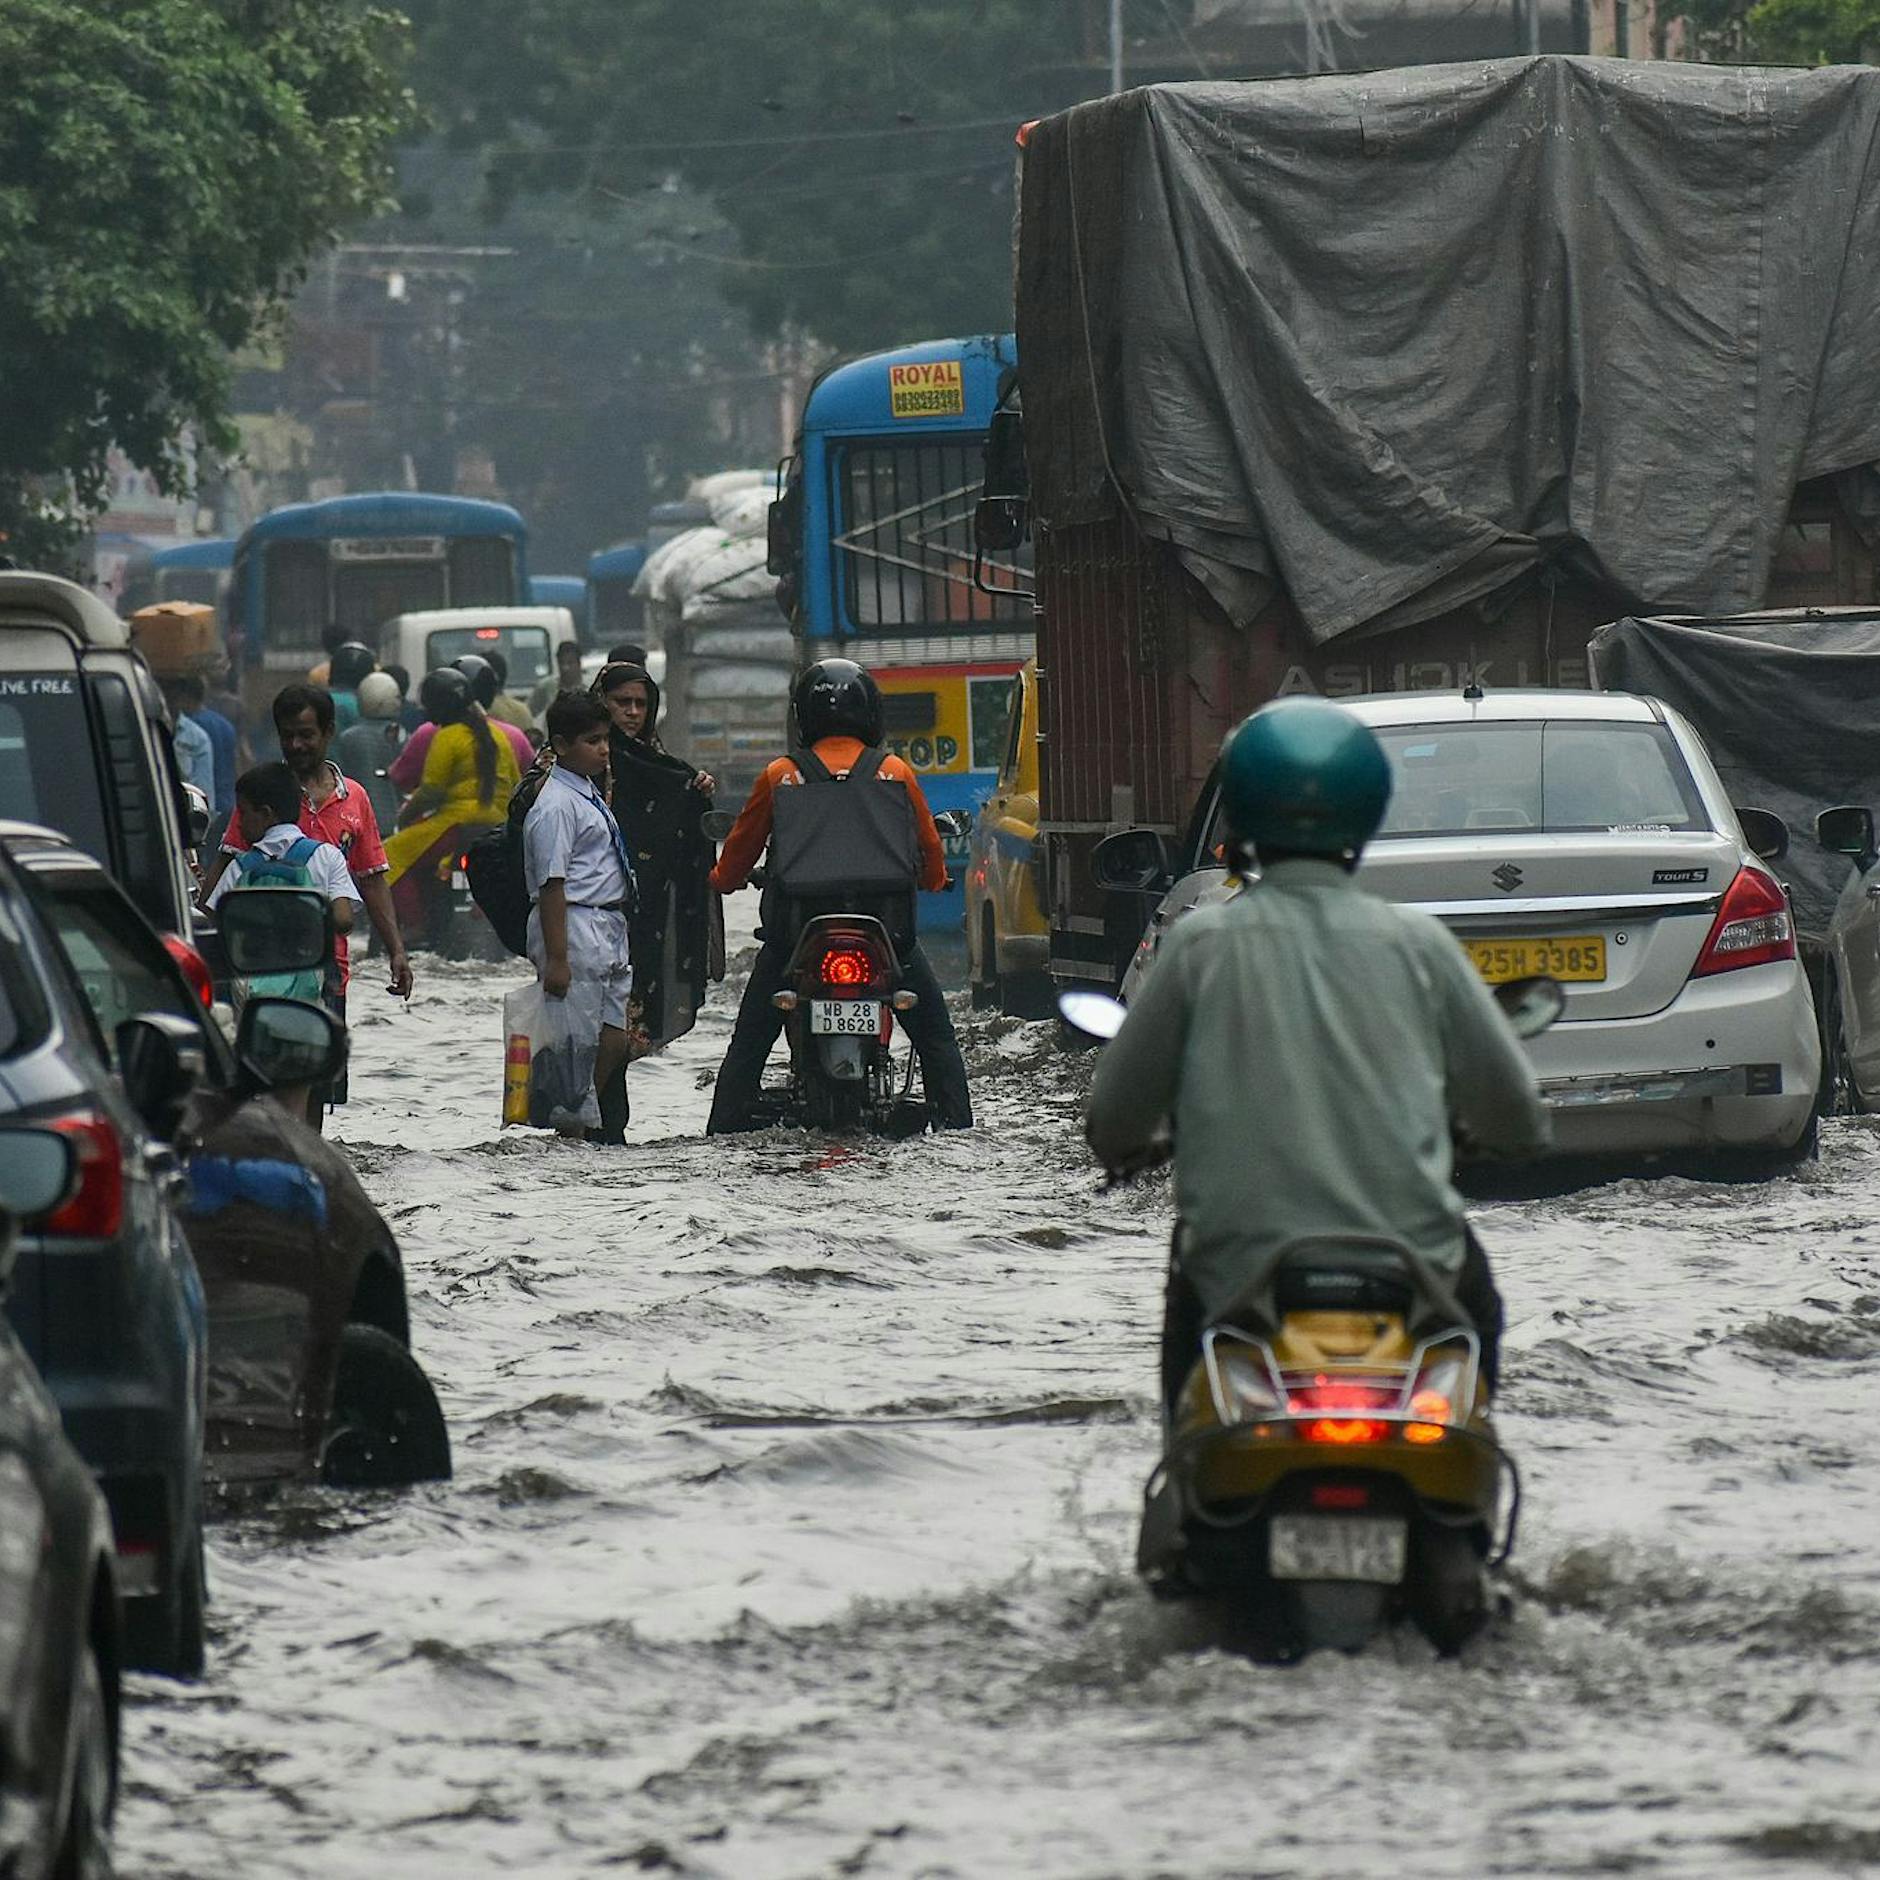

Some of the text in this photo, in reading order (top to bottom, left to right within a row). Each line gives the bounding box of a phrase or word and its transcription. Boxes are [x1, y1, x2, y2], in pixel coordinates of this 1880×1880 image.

[892, 364, 958, 386] ROYAL
[31, 679, 73, 694] FREE
[880, 735, 957, 770] TOP
[1535, 946, 1599, 973] 3385
[823, 1003, 871, 1017] WB 28
[823, 1018, 875, 1032] D 8628
